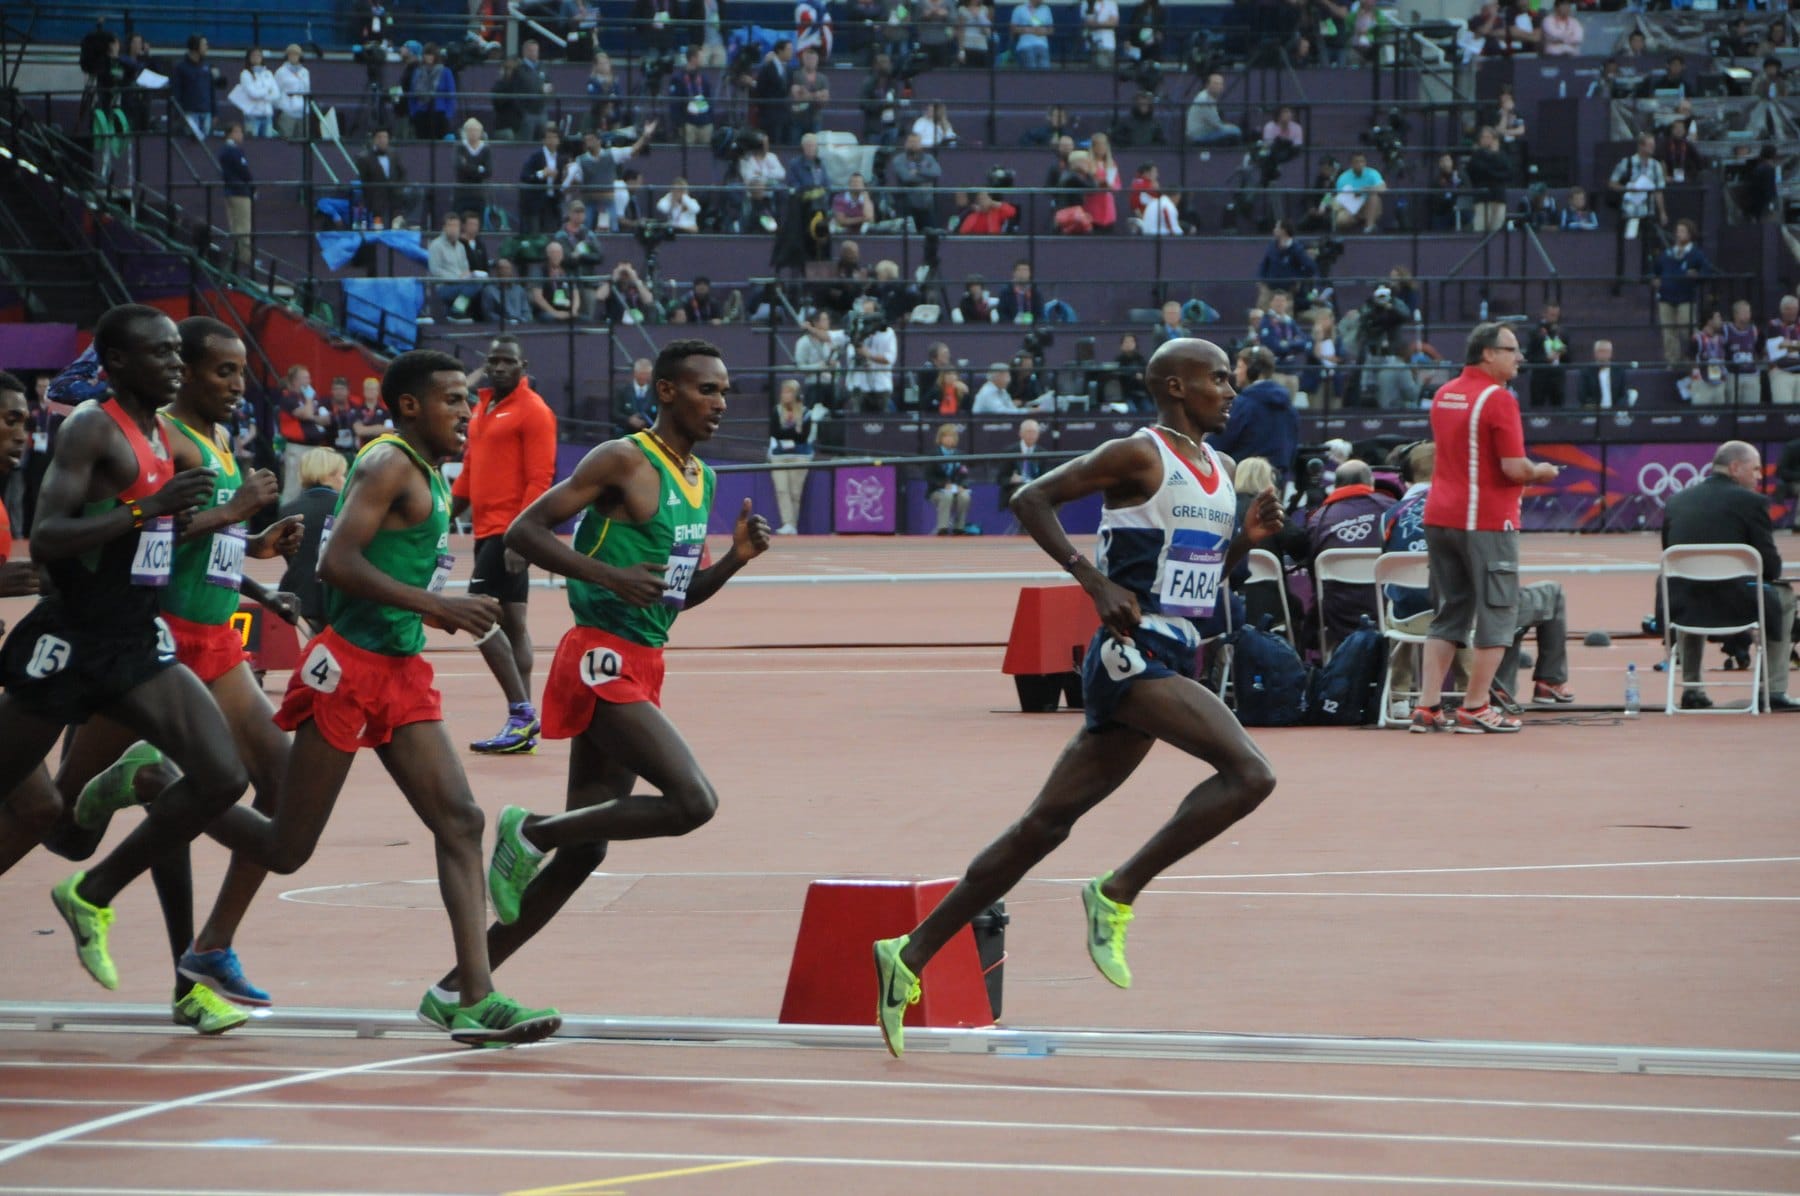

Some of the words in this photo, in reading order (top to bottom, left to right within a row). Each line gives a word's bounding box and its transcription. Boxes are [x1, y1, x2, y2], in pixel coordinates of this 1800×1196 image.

[1172, 505, 1208, 519] GREAT
[34, 638, 65, 675] 15
[310, 656, 328, 685] 4
[586, 650, 617, 681] 10
[1111, 640, 1131, 673] 3
